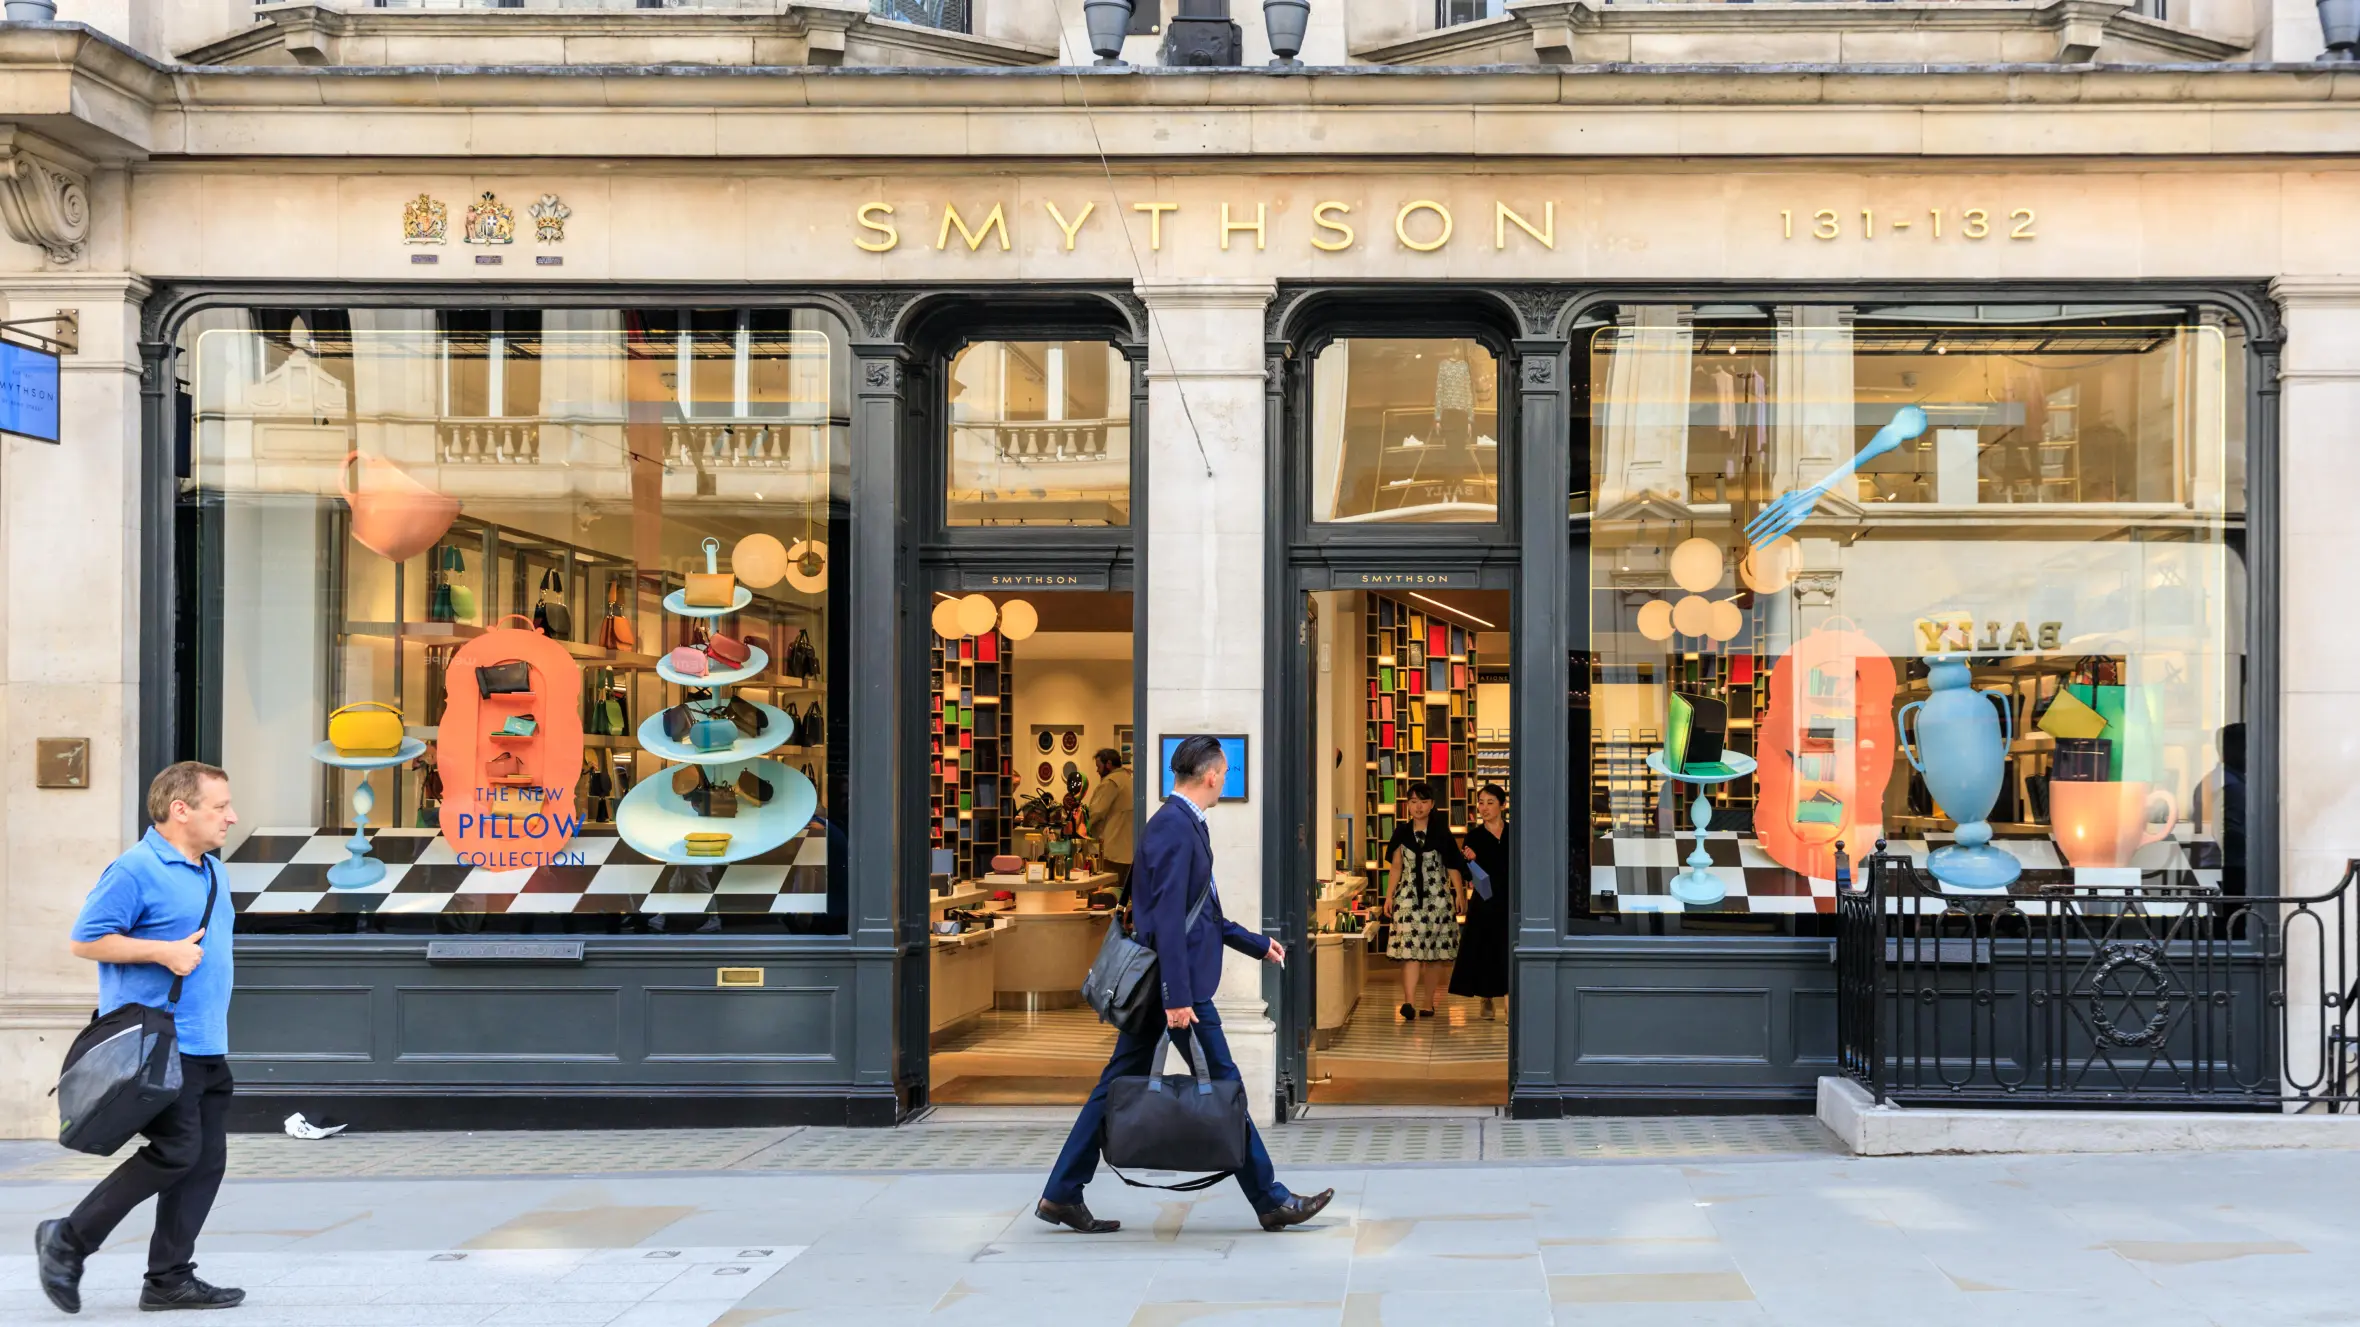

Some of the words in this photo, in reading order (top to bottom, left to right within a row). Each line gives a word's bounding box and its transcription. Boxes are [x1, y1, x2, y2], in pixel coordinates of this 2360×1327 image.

[854, 199, 1554, 252] SMYTHSON
[1780, 207, 2037, 240] 131-132
[992, 576, 1077, 584] SMYTHSON
[1362, 575, 1448, 583] SMYTHSON
[476, 787, 509, 801] THE
[518, 787, 564, 801] NEW
[459, 813, 587, 839] PILLOW
[457, 851, 585, 867] COLLECTION
[444, 945, 567, 955] SMYTHSON
